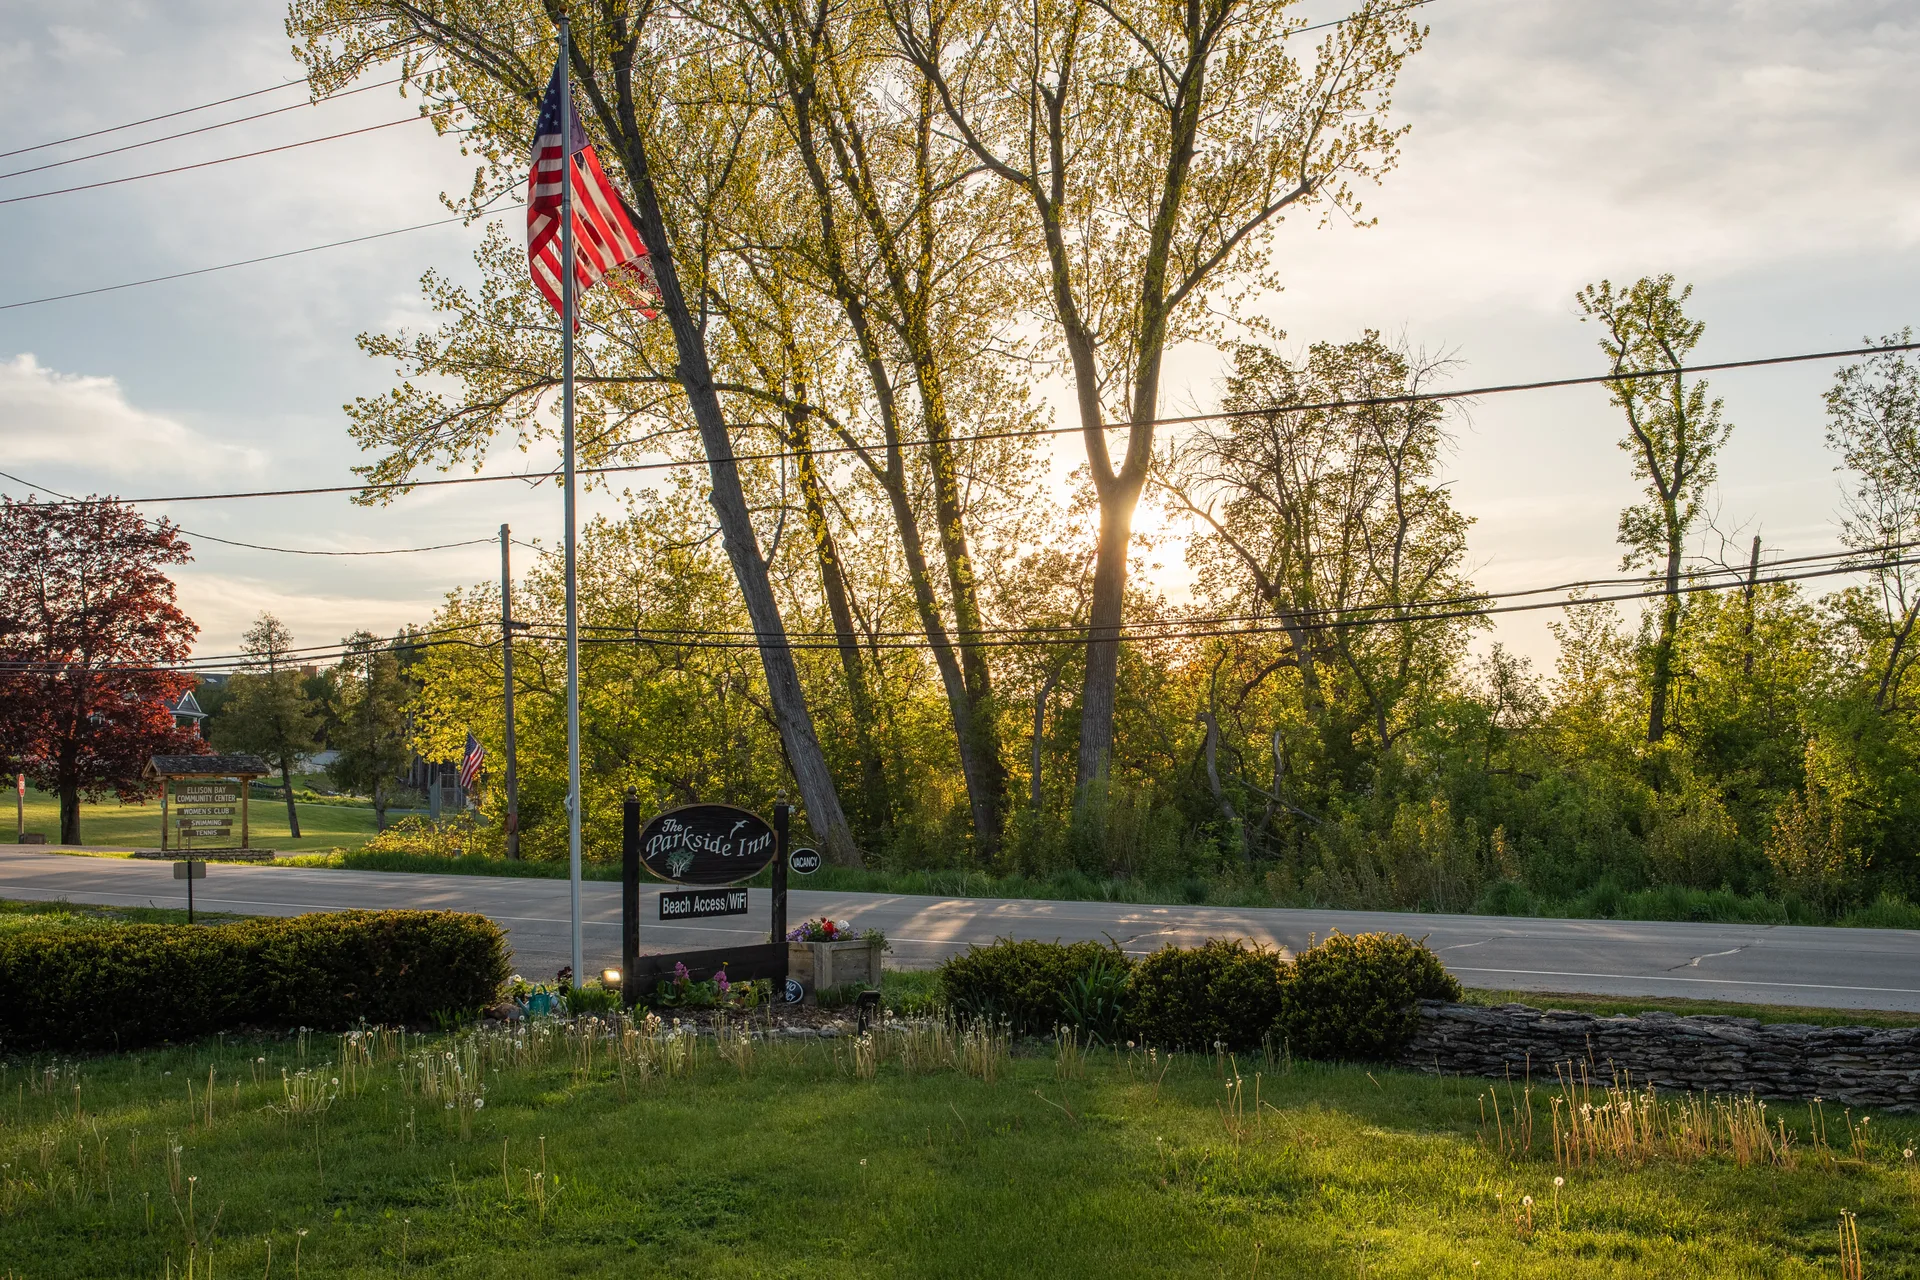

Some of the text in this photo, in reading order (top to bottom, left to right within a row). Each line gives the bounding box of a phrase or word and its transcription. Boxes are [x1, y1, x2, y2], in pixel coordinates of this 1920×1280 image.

[187, 786, 227, 794] ELLISON BAY
[215, 794, 236, 802] CENTER
[662, 818, 684, 833] The
[645, 826, 772, 861] Parkside Inn
[792, 856, 818, 868] VACANCY
[663, 892, 747, 915] Beach Access/WiFi
